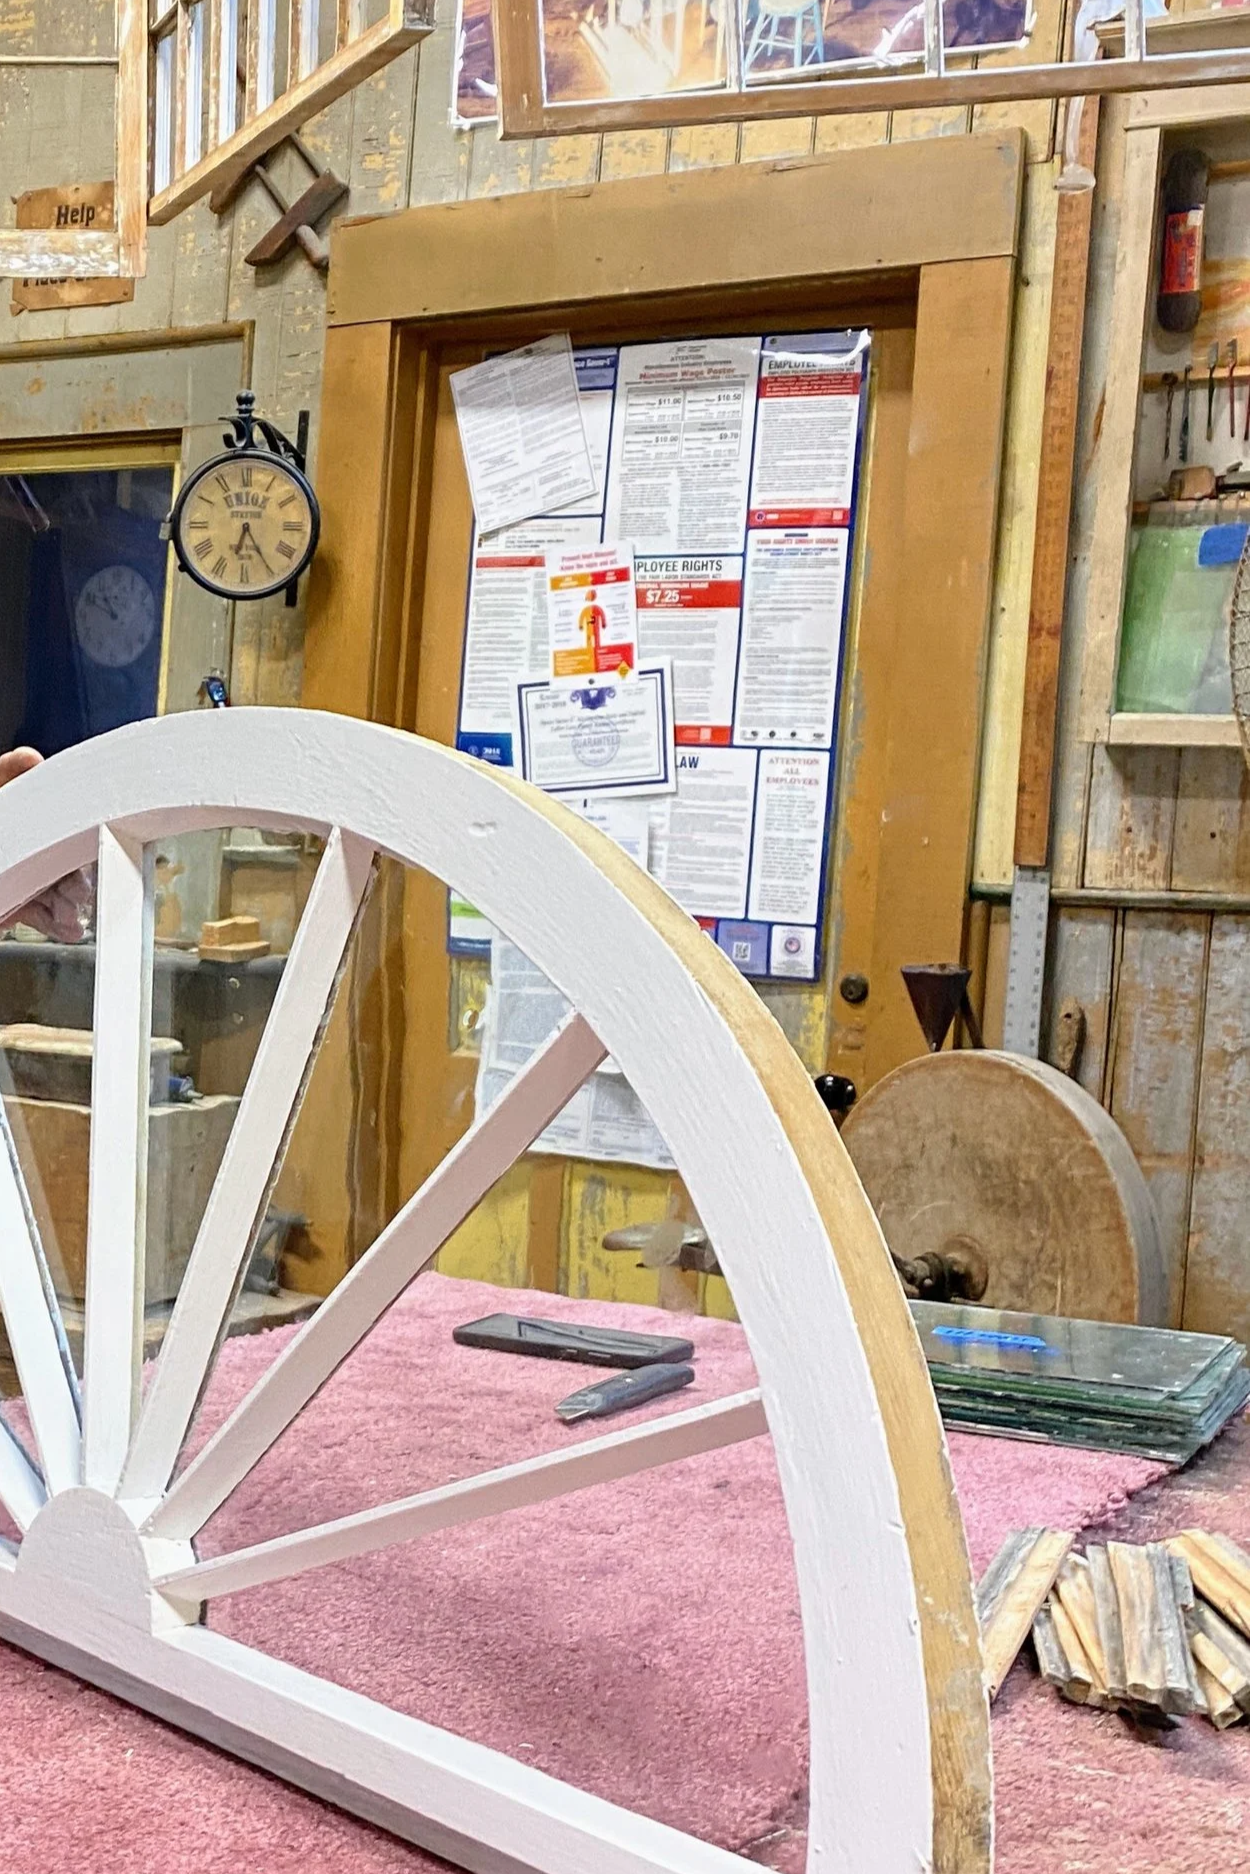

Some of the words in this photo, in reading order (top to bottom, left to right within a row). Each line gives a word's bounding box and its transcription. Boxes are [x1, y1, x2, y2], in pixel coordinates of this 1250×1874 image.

[56, 202, 95, 226] Help
[681, 369, 704, 378] Wage
[707, 367, 736, 375] Poster
[634, 560, 678, 572] PLOYEE
[682, 559, 723, 572] RIGHTS
[646, 589, 680, 604] $7.25
[571, 734, 621, 748] GUARANTEED
[768, 757, 820, 766] ATTENTION
[783, 767, 801, 775] ALL
[766, 776, 820, 786] EMPLOYEES
